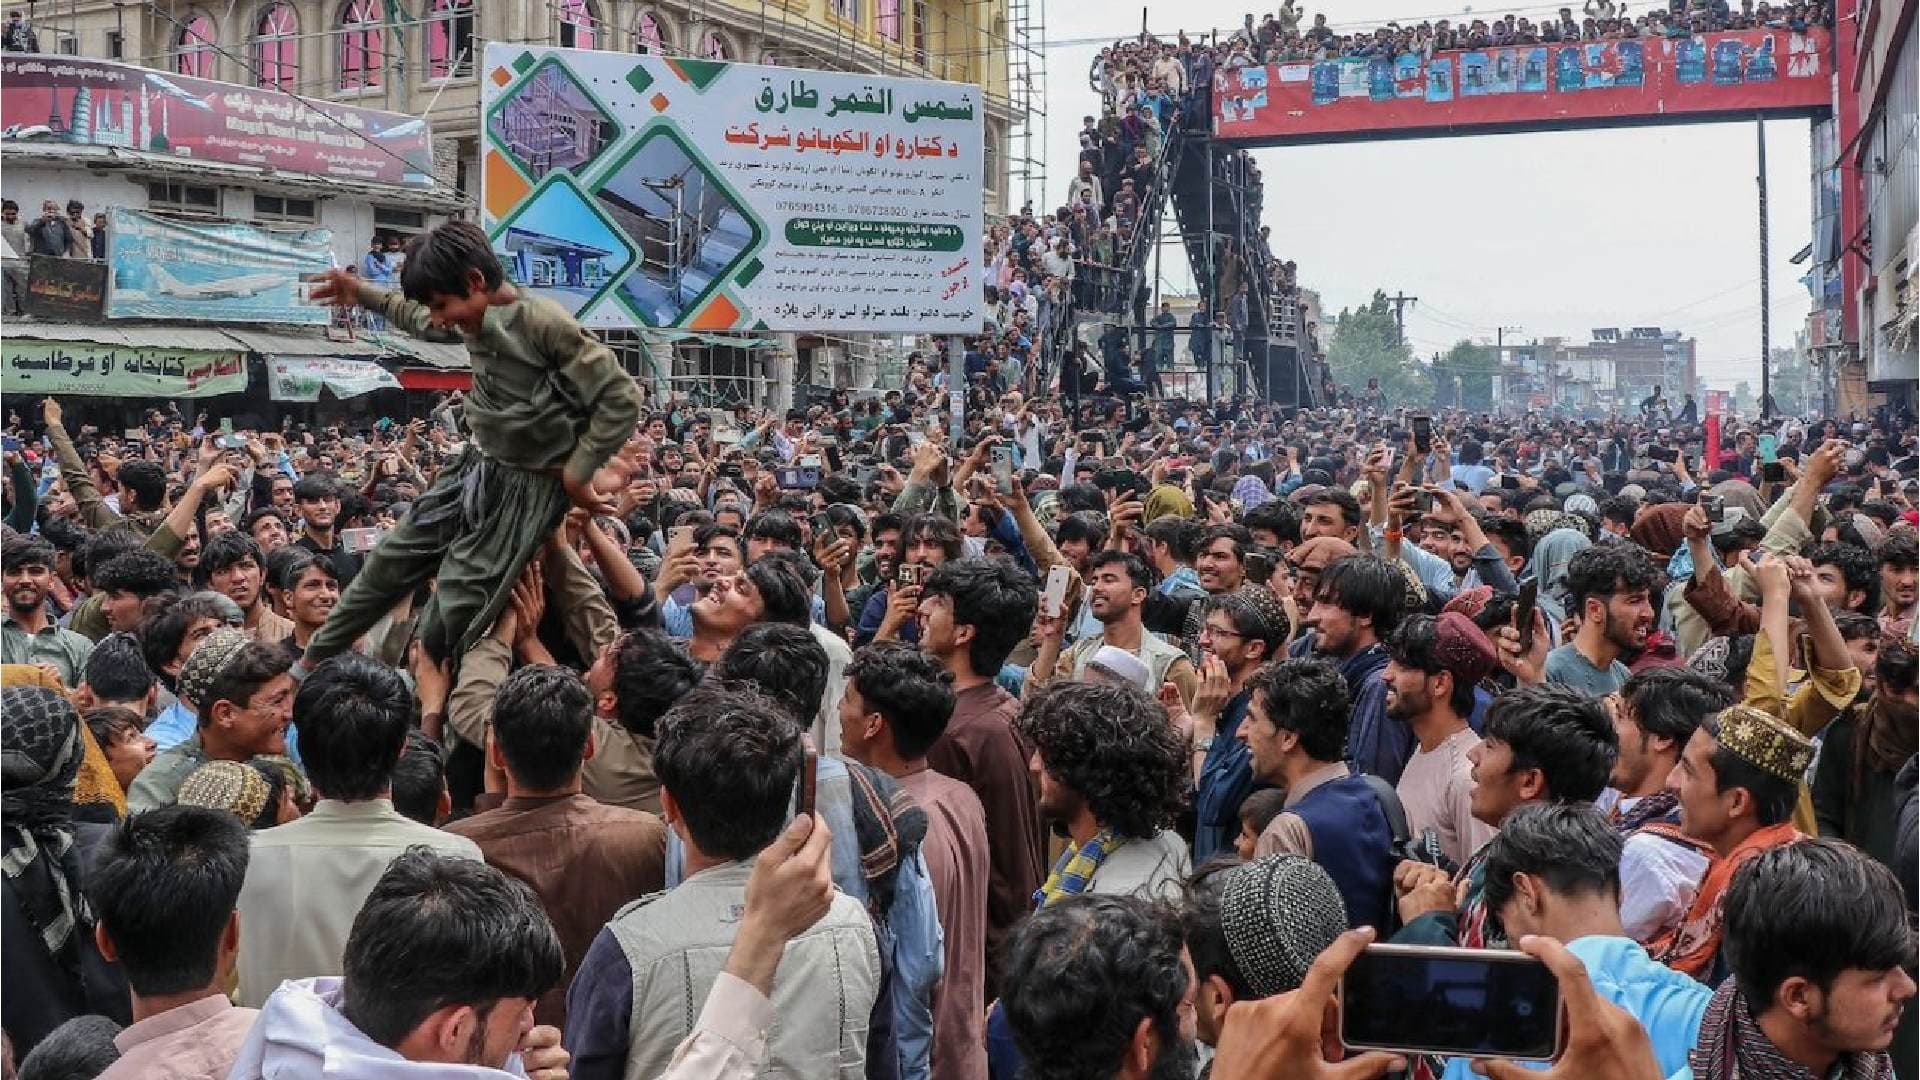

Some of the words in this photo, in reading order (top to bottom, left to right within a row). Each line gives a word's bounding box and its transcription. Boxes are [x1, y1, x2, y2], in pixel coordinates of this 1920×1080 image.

[755, 77, 819, 113] طارق
[825, 86, 893, 117] القمر
[902, 93, 974, 122] شمس
[724, 122, 792, 150] شرکت
[875, 133, 889, 158] او
[947, 140, 958, 157] د
[943, 307, 974, 322] خوست
[101, 351, 116, 376] او
